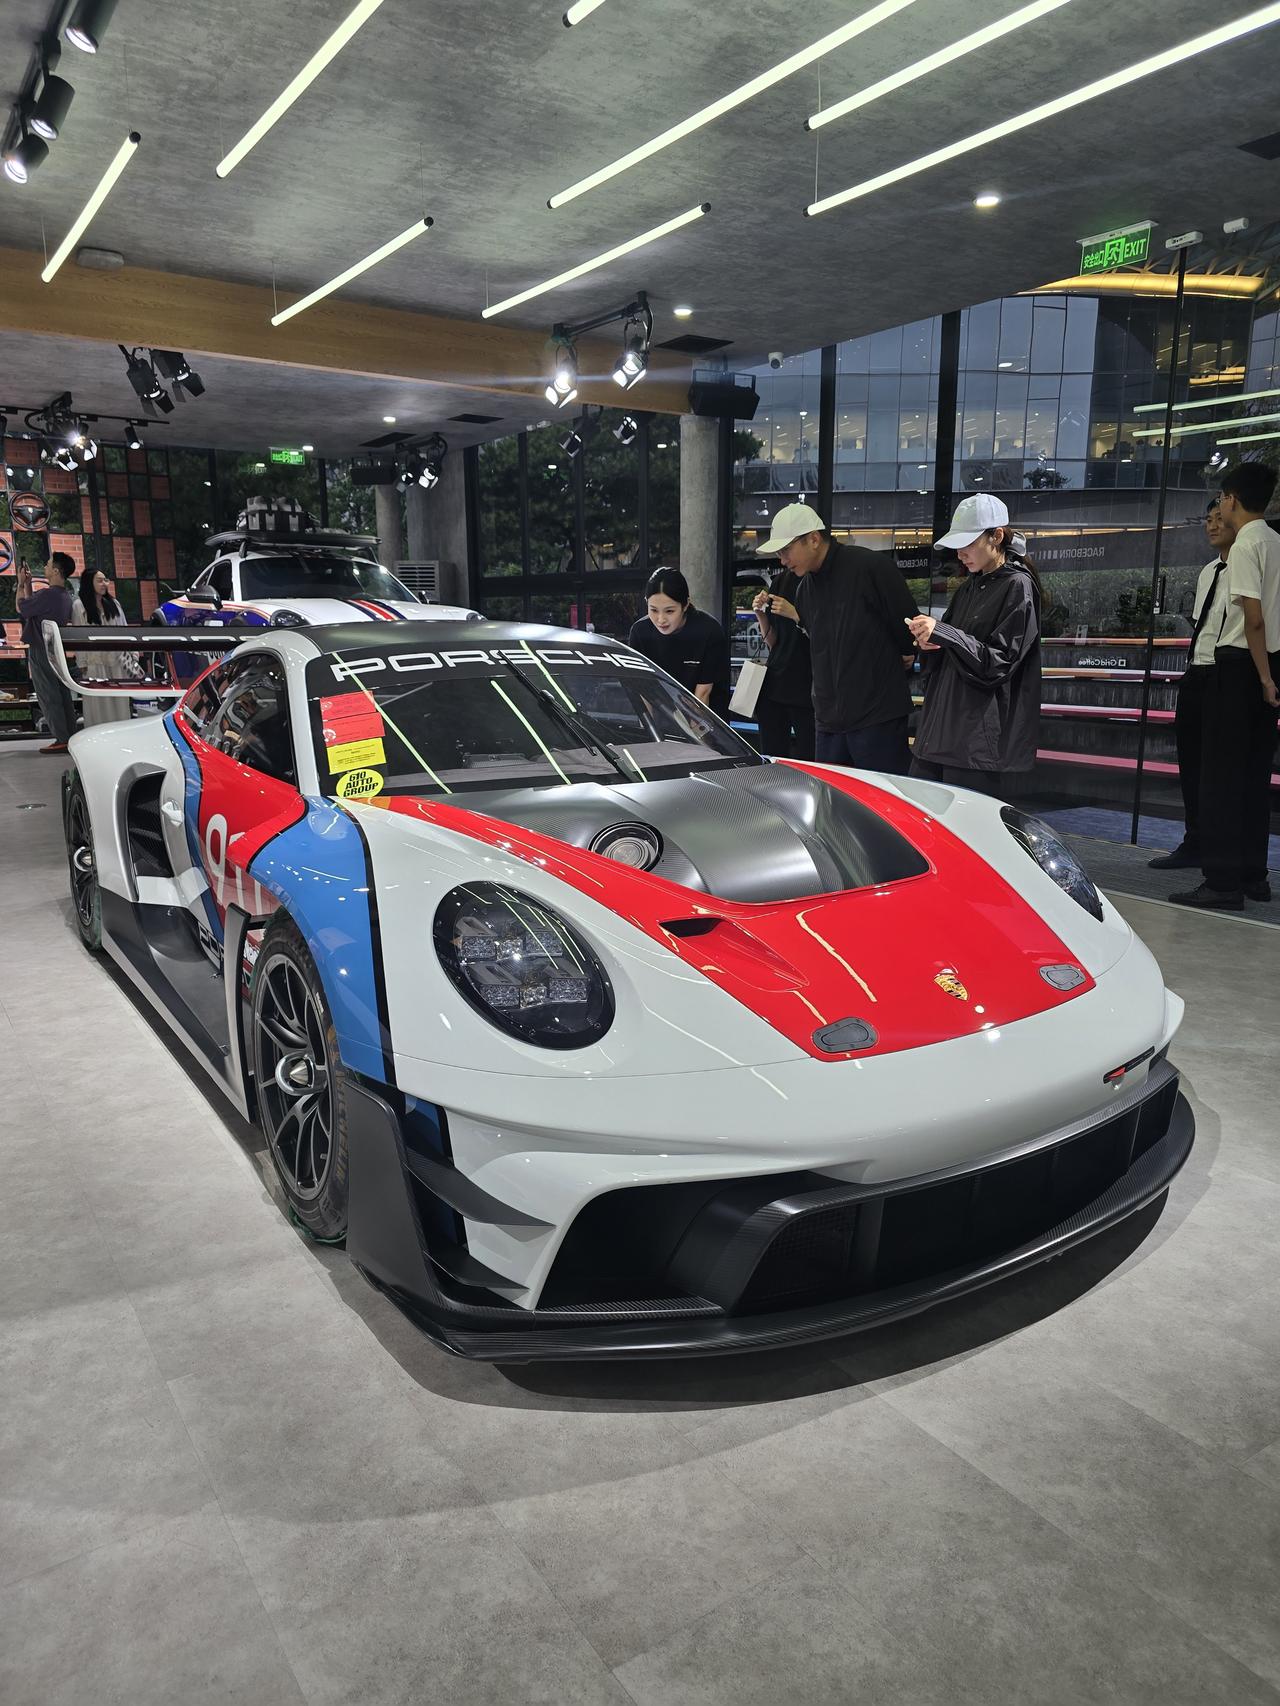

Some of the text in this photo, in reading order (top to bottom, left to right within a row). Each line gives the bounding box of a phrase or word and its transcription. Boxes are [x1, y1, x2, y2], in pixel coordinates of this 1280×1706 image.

[1123, 238, 1147, 258] EXIT
[329, 649, 656, 682] PORSCHE
[345, 776, 373, 790] AUTO
[349, 771, 367, 782] 610
[343, 782, 379, 798] GROUP
